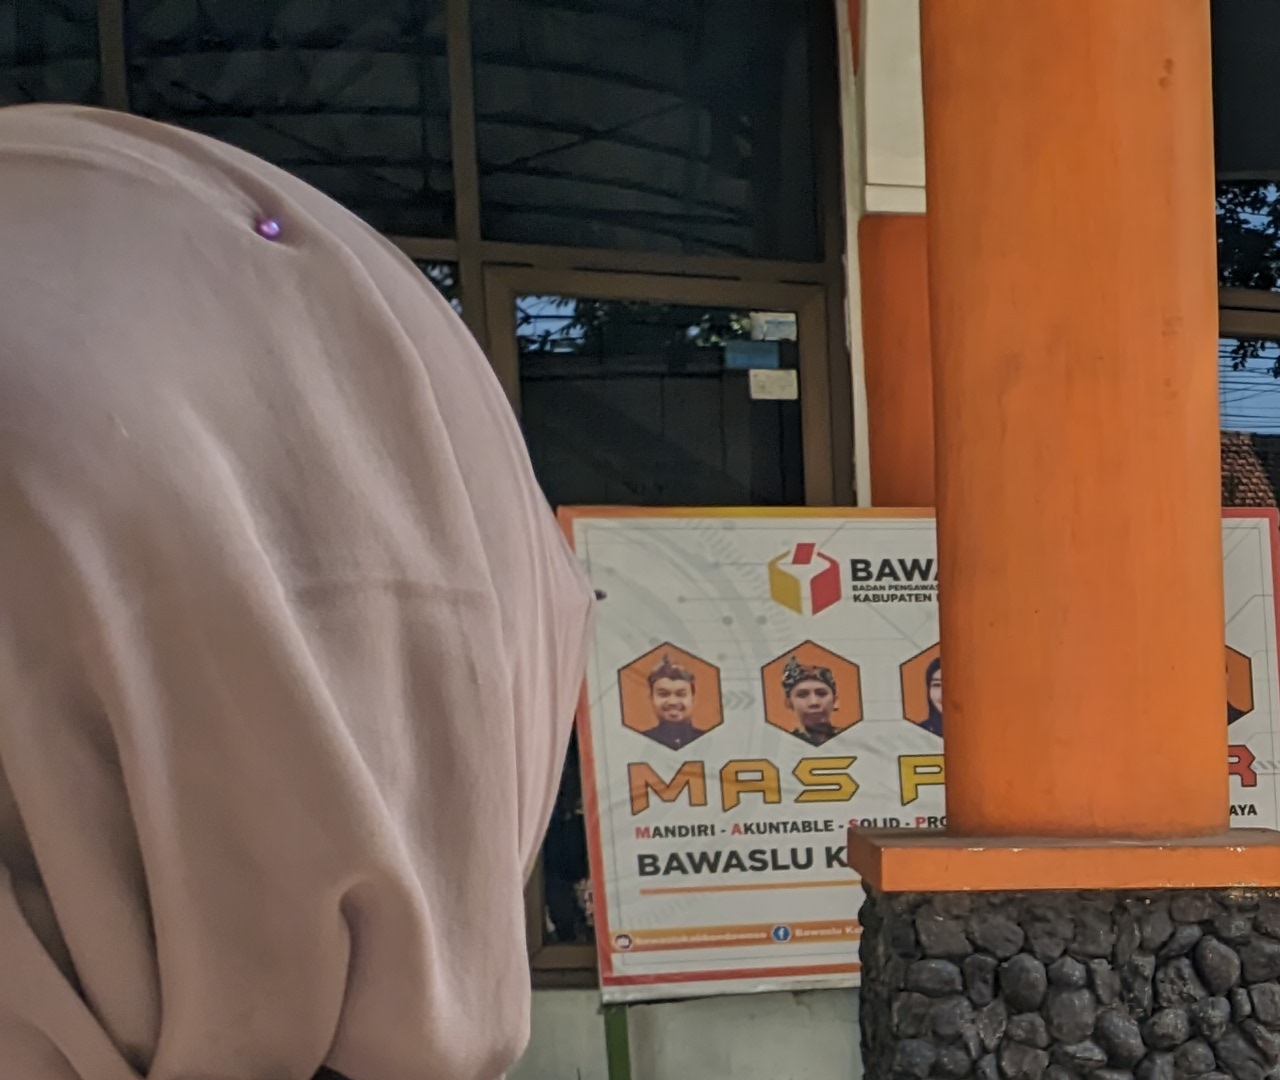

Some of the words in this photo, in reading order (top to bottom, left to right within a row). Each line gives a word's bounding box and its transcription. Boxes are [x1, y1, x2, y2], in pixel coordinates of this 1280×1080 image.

[852, 584, 886, 592] BADAN
[853, 592, 932, 603] KABUPATEN
[627, 756, 860, 816] MAS
[635, 824, 716, 839] MANDIRI
[731, 819, 835, 837] AKUNTABLE
[637, 846, 814, 877] BAWASLU
